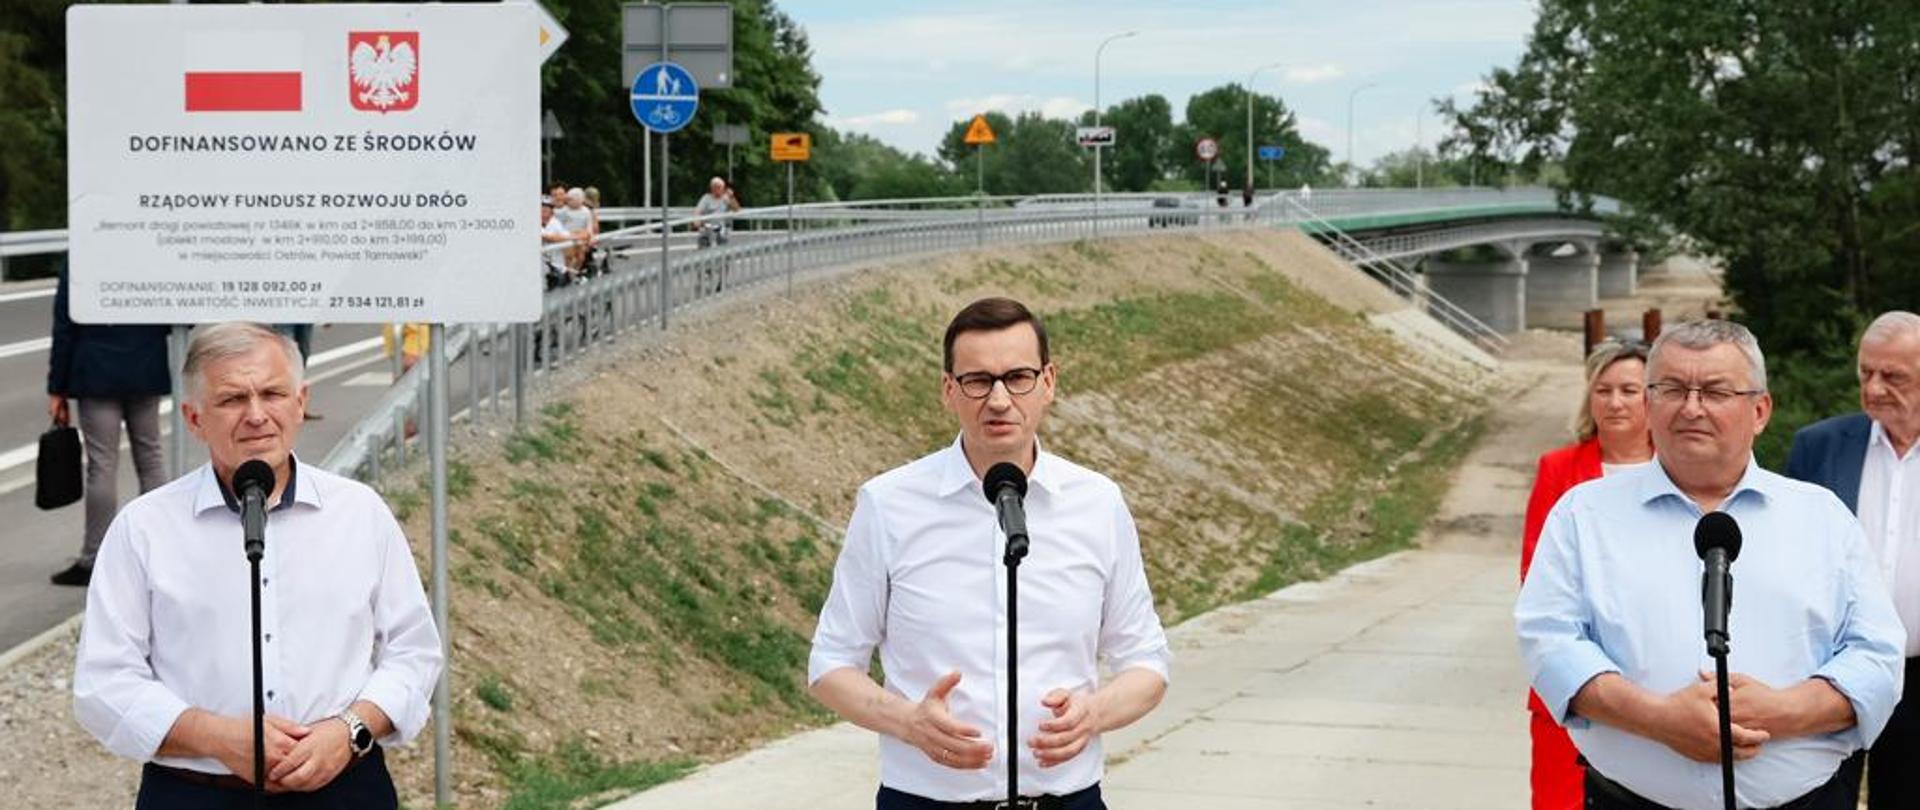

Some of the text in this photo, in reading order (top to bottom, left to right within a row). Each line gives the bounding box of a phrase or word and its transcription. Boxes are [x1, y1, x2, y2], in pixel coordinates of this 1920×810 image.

[129, 131, 477, 152] DOFINANSOWANO ZE ŚRODKÓW
[139, 190, 469, 211] RZĄDOWY FUNDUSZ ROZWOJU DRÓG
[222, 281, 235, 292] 19
[239, 281, 259, 292] 128
[100, 296, 172, 308] CAŁKOWITA
[329, 297, 344, 308] 27
